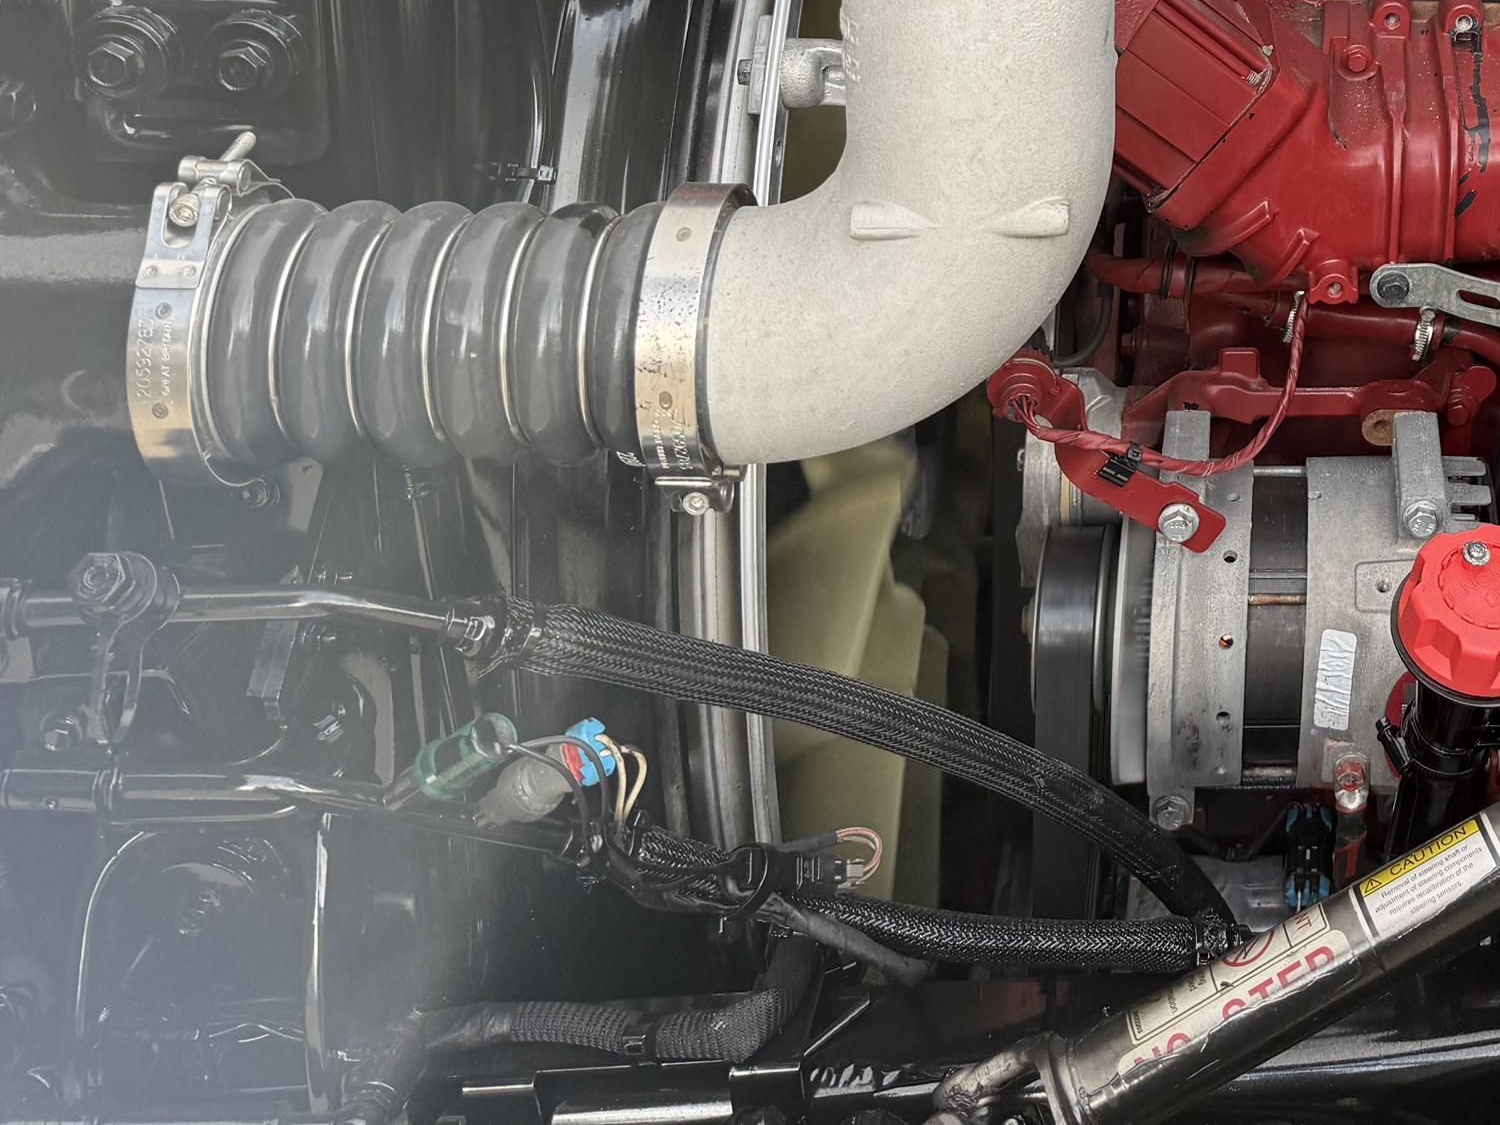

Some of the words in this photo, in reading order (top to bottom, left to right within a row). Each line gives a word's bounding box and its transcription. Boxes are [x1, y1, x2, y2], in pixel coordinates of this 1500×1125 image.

[1390, 825, 1467, 876] CAUTION
[1375, 889, 1410, 913] adjustment
[1418, 870, 1444, 889] steering
[1444, 847, 1482, 875] components
[1381, 877, 1409, 898] Removal
[1418, 859, 1444, 878] steering
[1389, 897, 1415, 916] requires
[1416, 875, 1454, 900] recalibration
[1410, 896, 1436, 915] steering
